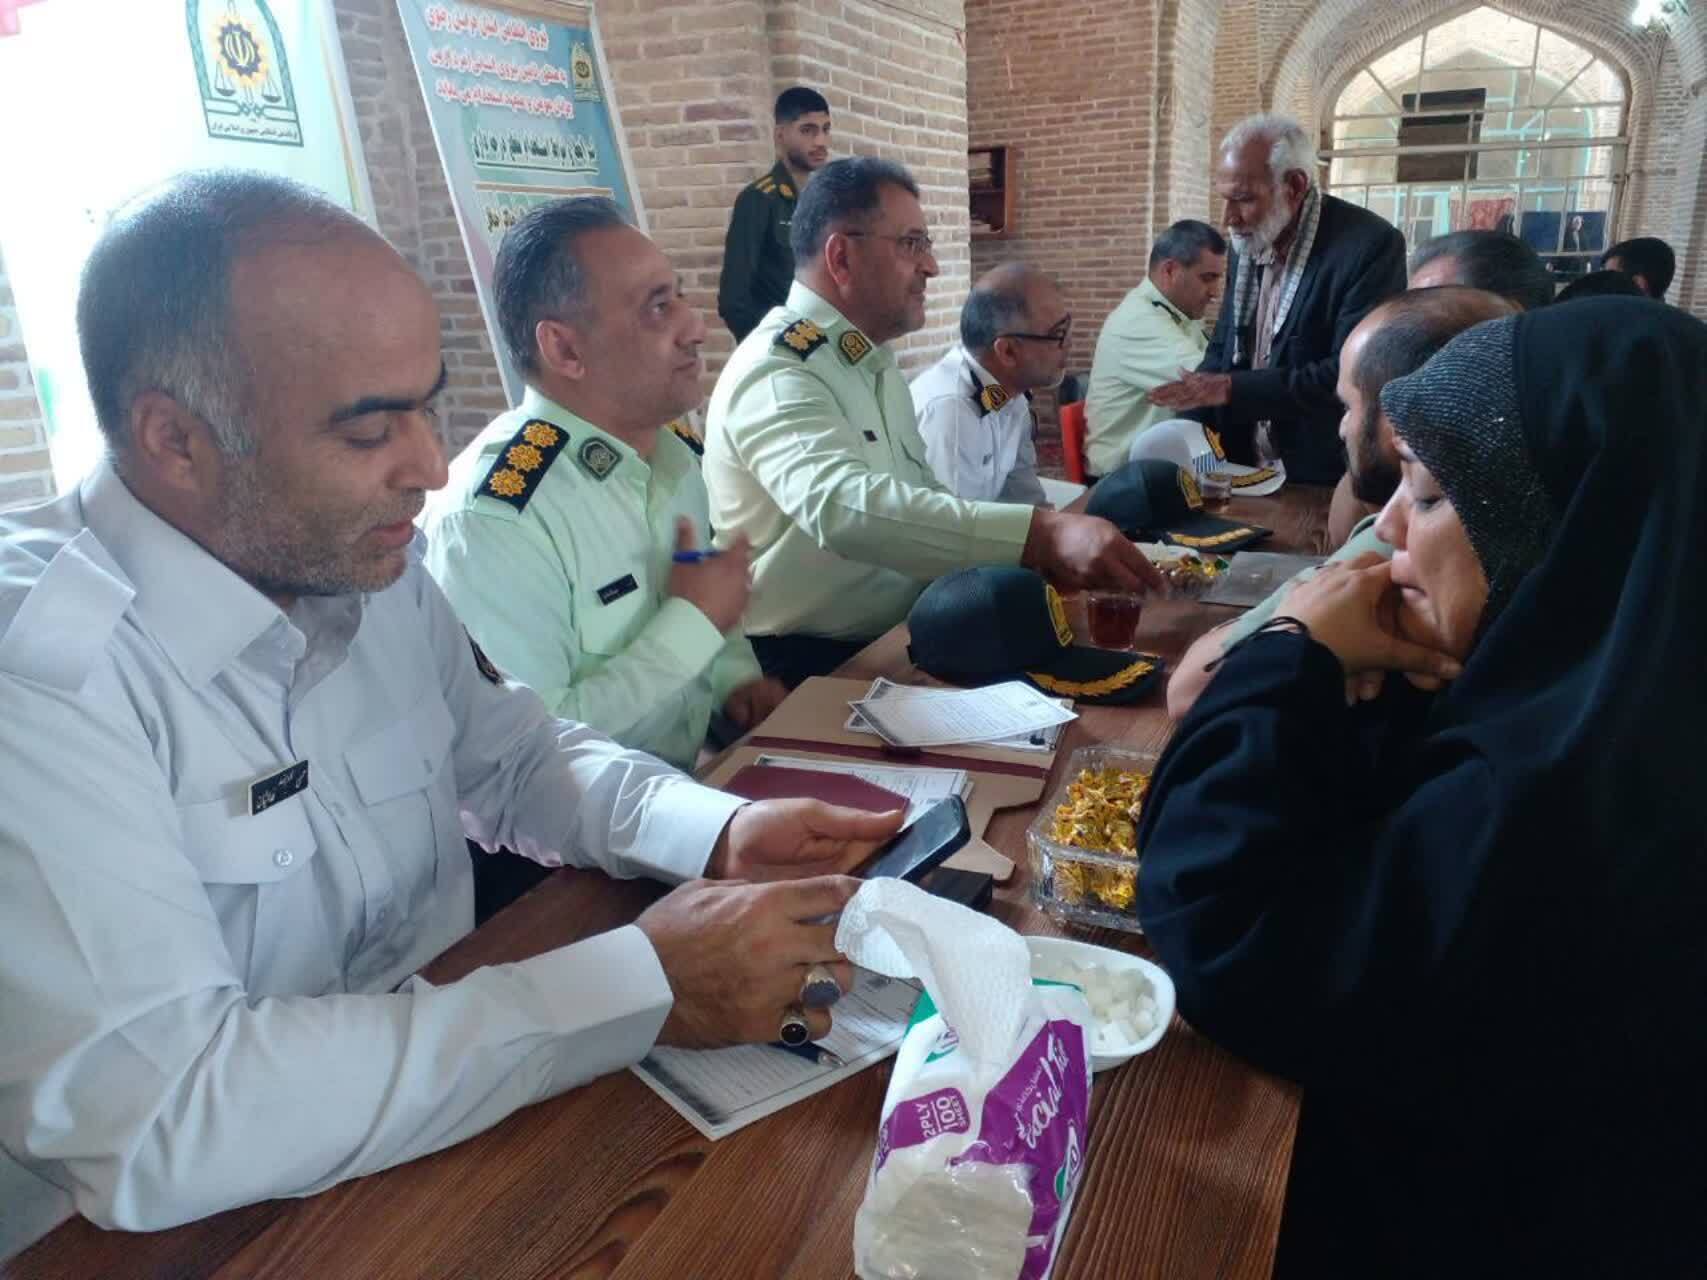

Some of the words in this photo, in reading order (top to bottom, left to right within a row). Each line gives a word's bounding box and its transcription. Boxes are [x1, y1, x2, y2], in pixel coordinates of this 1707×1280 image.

[916, 1103, 937, 1138] 2PLY
[936, 1096, 959, 1131] 100
[949, 1095, 967, 1128] SHEET
